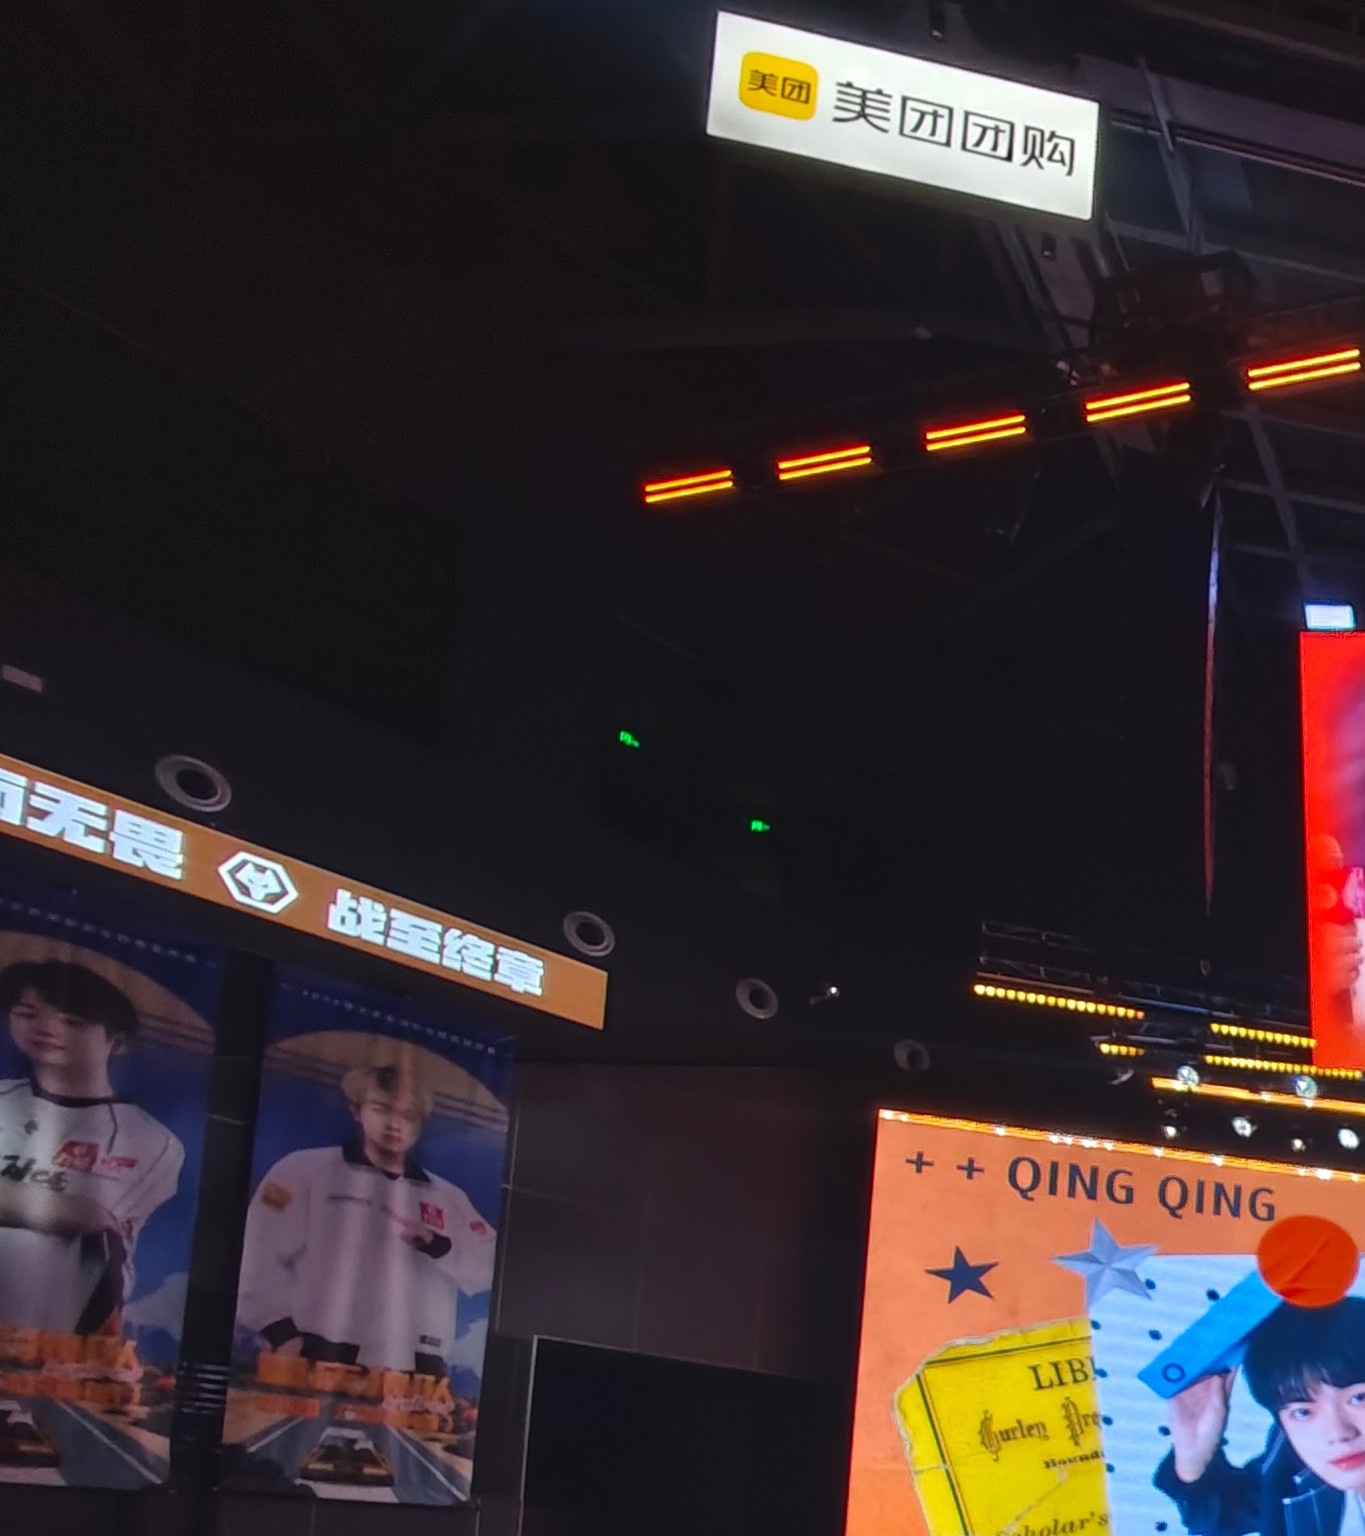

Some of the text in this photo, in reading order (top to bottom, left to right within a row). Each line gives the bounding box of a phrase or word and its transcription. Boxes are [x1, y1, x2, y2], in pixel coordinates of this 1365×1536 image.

[747, 68, 1075, 177] 美团 美团团购
[326, 887, 545, 997] 战至终章
[1007, 1156, 1276, 1222] QING QING
